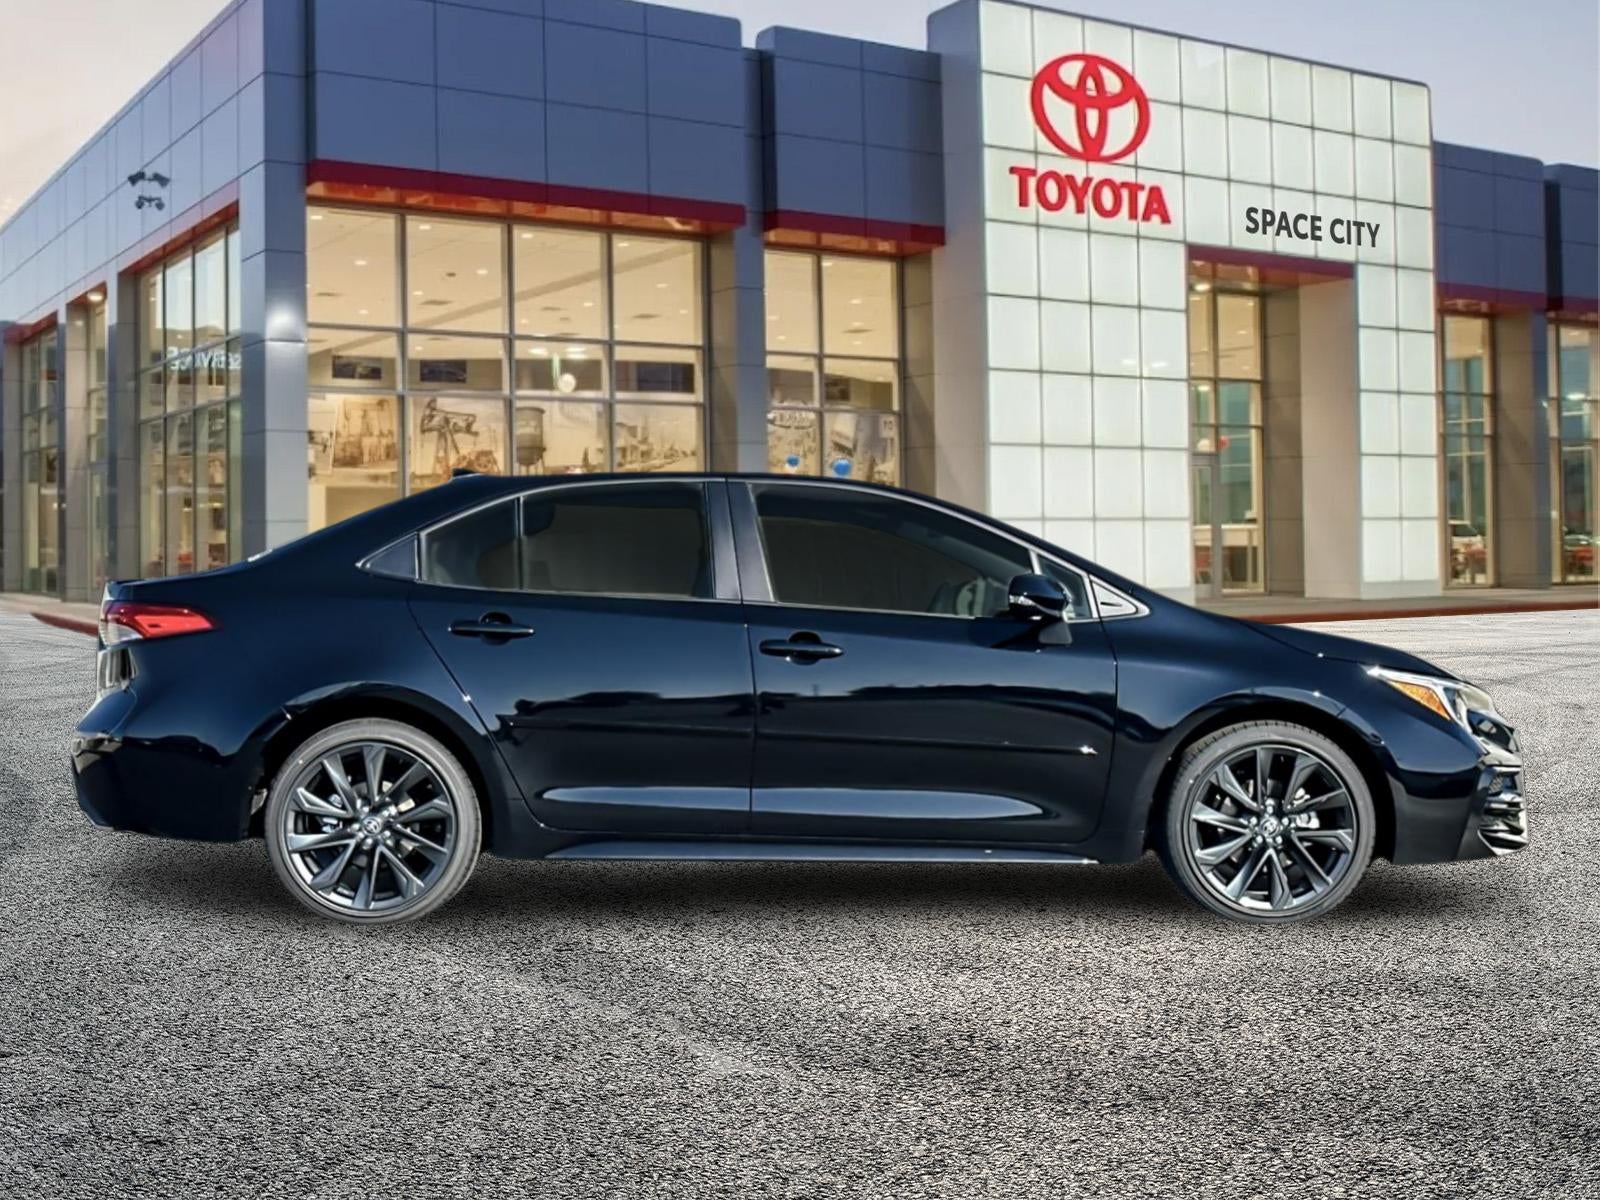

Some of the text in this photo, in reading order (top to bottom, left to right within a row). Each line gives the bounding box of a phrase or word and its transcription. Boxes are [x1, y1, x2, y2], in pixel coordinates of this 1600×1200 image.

[1009, 166, 1171, 224] TOYOTA
[1245, 207, 1380, 247] SPACE CITY
